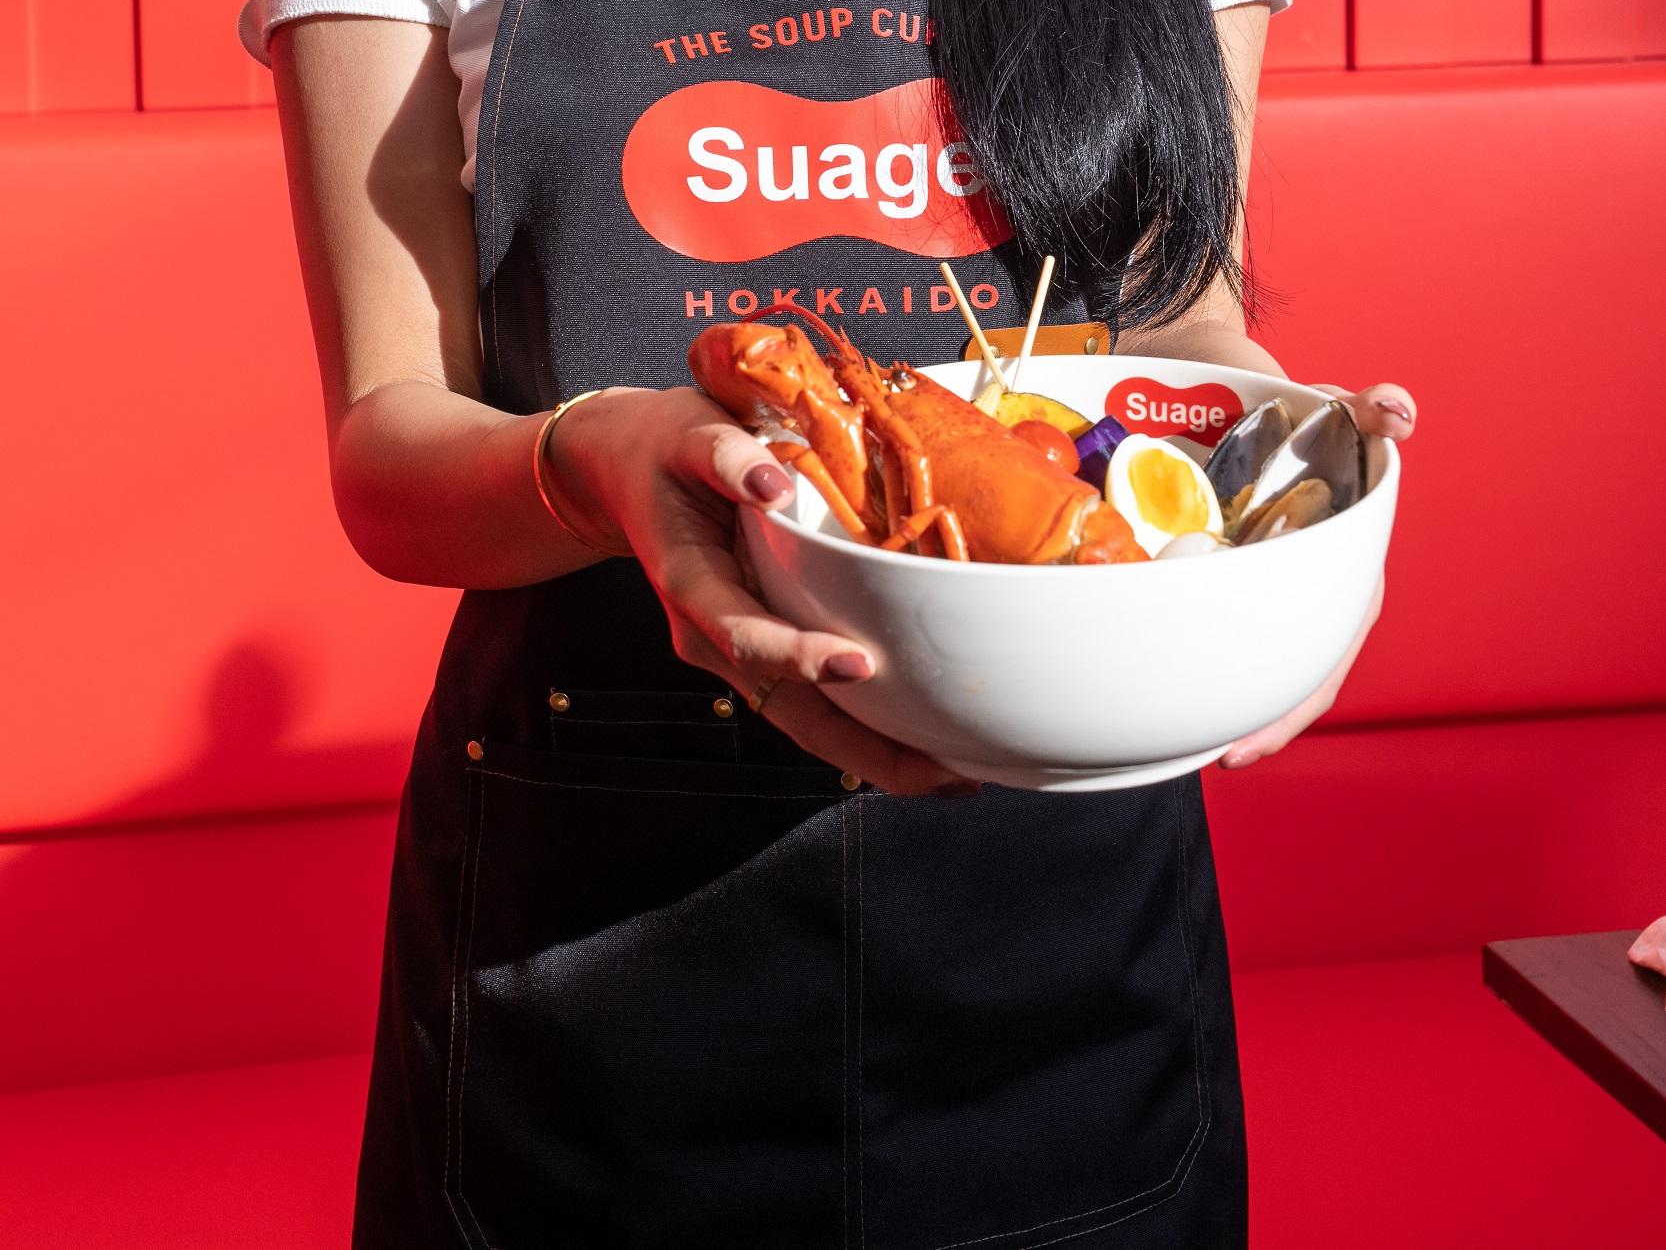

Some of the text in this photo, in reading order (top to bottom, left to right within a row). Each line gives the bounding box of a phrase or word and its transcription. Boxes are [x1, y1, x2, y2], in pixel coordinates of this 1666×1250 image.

[653, 30, 733, 65] THE
[748, 7, 854, 50] SOUP
[686, 126, 986, 219] Suage
[684, 283, 1000, 318] HOKKAIDO
[1125, 392, 1226, 433] Suage
